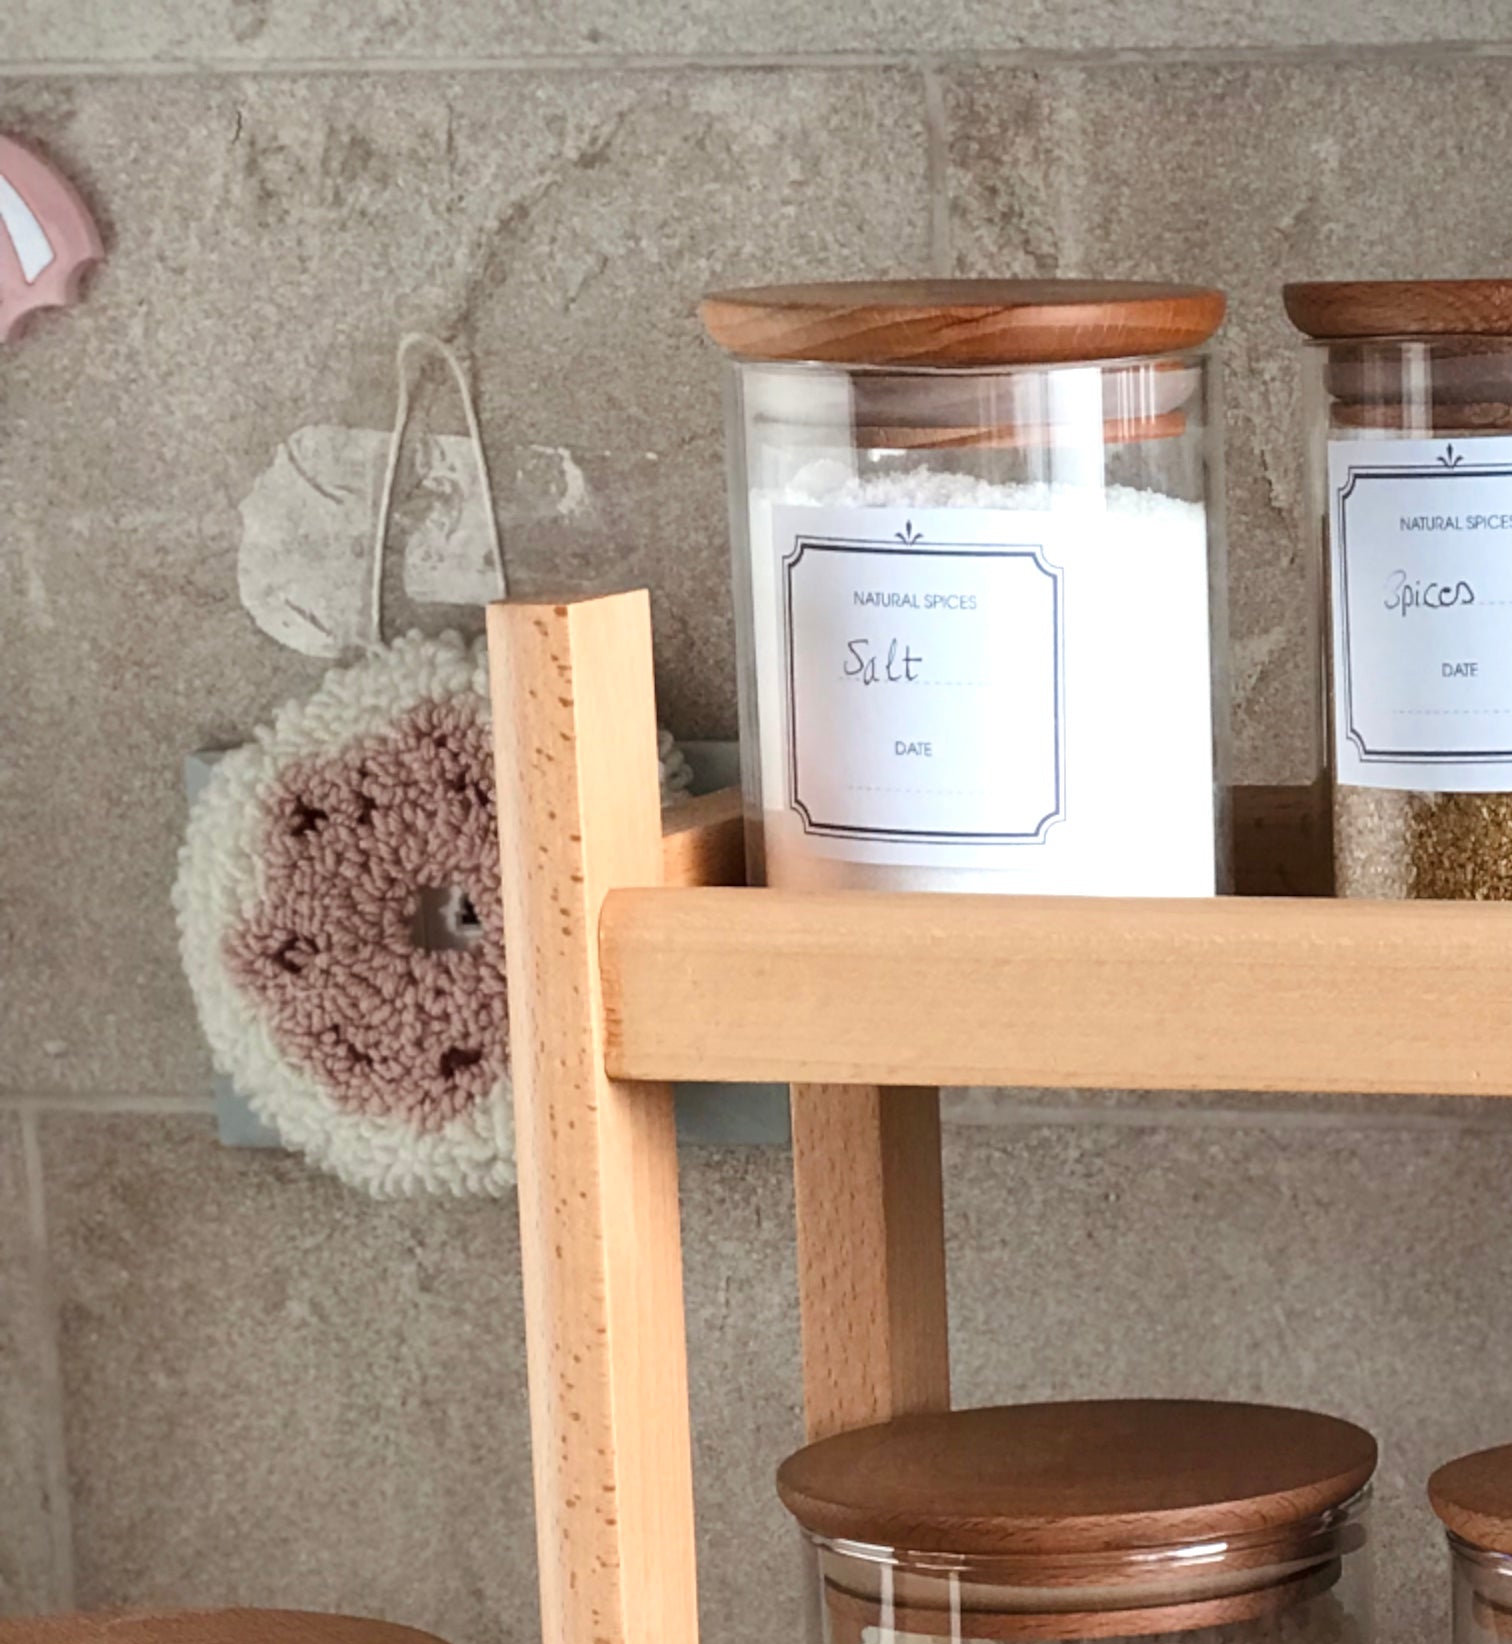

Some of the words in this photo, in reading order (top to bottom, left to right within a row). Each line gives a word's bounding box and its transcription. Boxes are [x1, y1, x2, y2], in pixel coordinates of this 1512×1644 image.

[1399, 516, 1463, 531] NATURAL
[853, 591, 920, 609] NATURAL
[924, 594, 977, 610] SPICES
[1384, 569, 1475, 617] Spices
[843, 637, 923, 686] Salt
[1441, 662, 1479, 678] DATE
[894, 740, 932, 757] DATE
